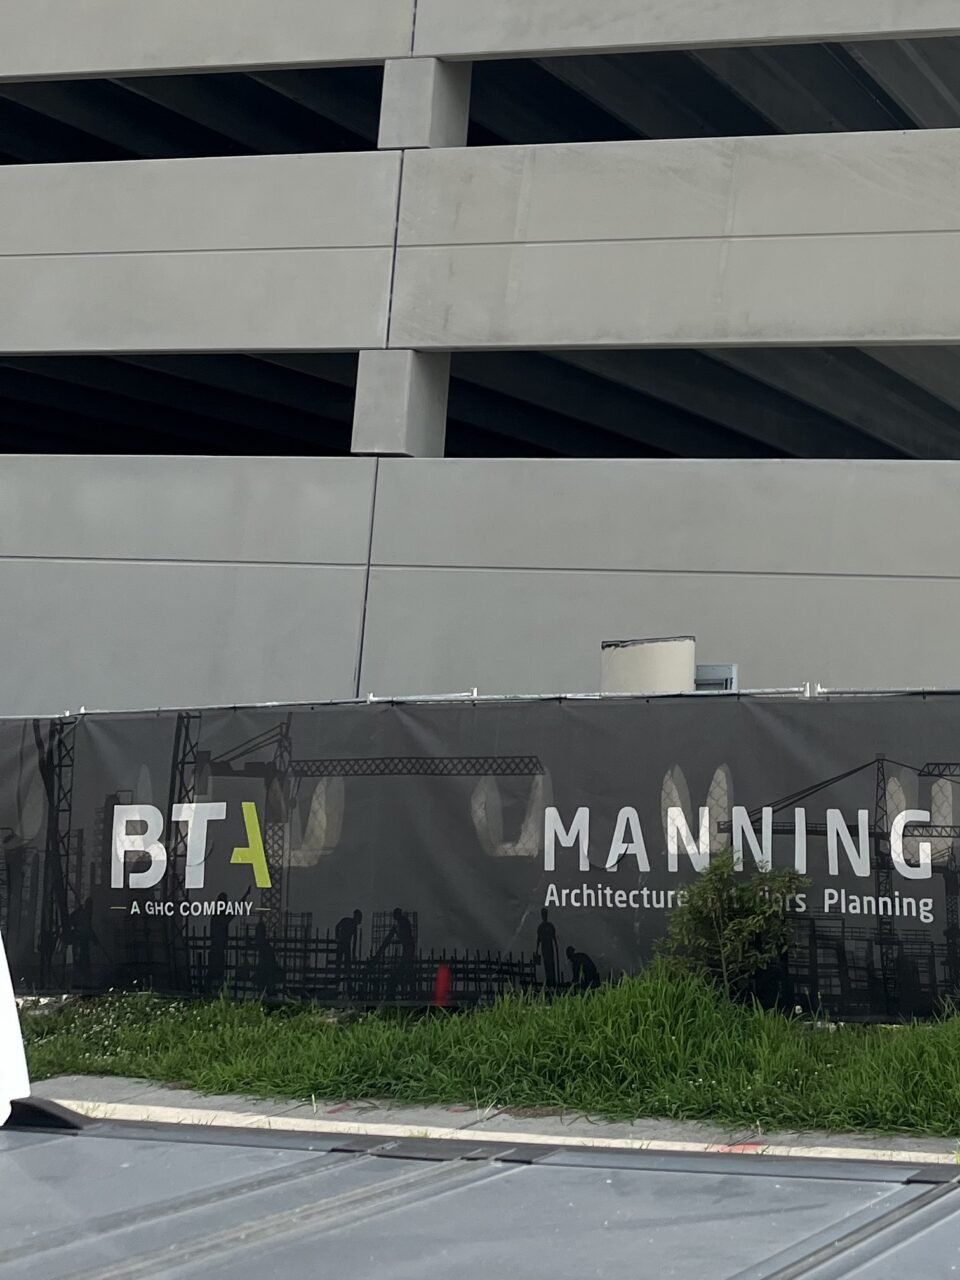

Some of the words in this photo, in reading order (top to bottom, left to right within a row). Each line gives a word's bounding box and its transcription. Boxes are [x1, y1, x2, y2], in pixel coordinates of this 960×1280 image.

[111, 802, 272, 889] BTA
[544, 806, 932, 879] MANNING
[130, 901, 141, 915] A
[145, 901, 175, 916] GHC
[179, 901, 254, 916] COMPANY
[545, 884, 688, 909] Architecture
[824, 888, 933, 923] Planning
